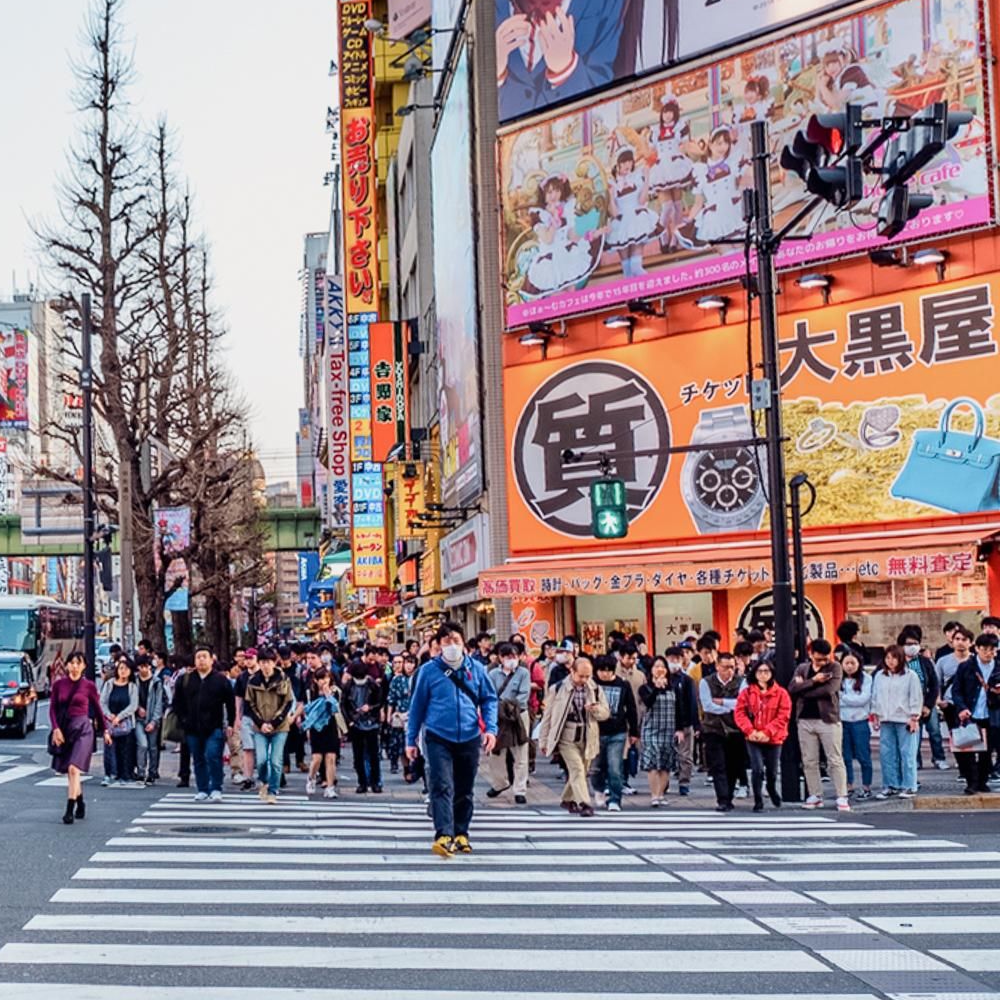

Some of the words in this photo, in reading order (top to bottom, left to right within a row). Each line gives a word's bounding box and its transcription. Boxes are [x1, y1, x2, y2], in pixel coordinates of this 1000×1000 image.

[342, 3, 367, 14] DVD
[346, 38, 364, 49] CD
[920, 162, 962, 187] cafe
[344, 116, 370, 296] お売り下さい
[327, 279, 344, 332] AKKY
[777, 284, 998, 390] 大黒屋
[329, 351, 346, 427] Tax-free
[373, 360, 393, 422] 吉野家
[331, 431, 348, 477] Shop
[532, 374, 652, 521] 質
[356, 556, 383, 565] AKIBA
[887, 551, 973, 577] 無料査定
[482, 578, 535, 594] 高価買取
